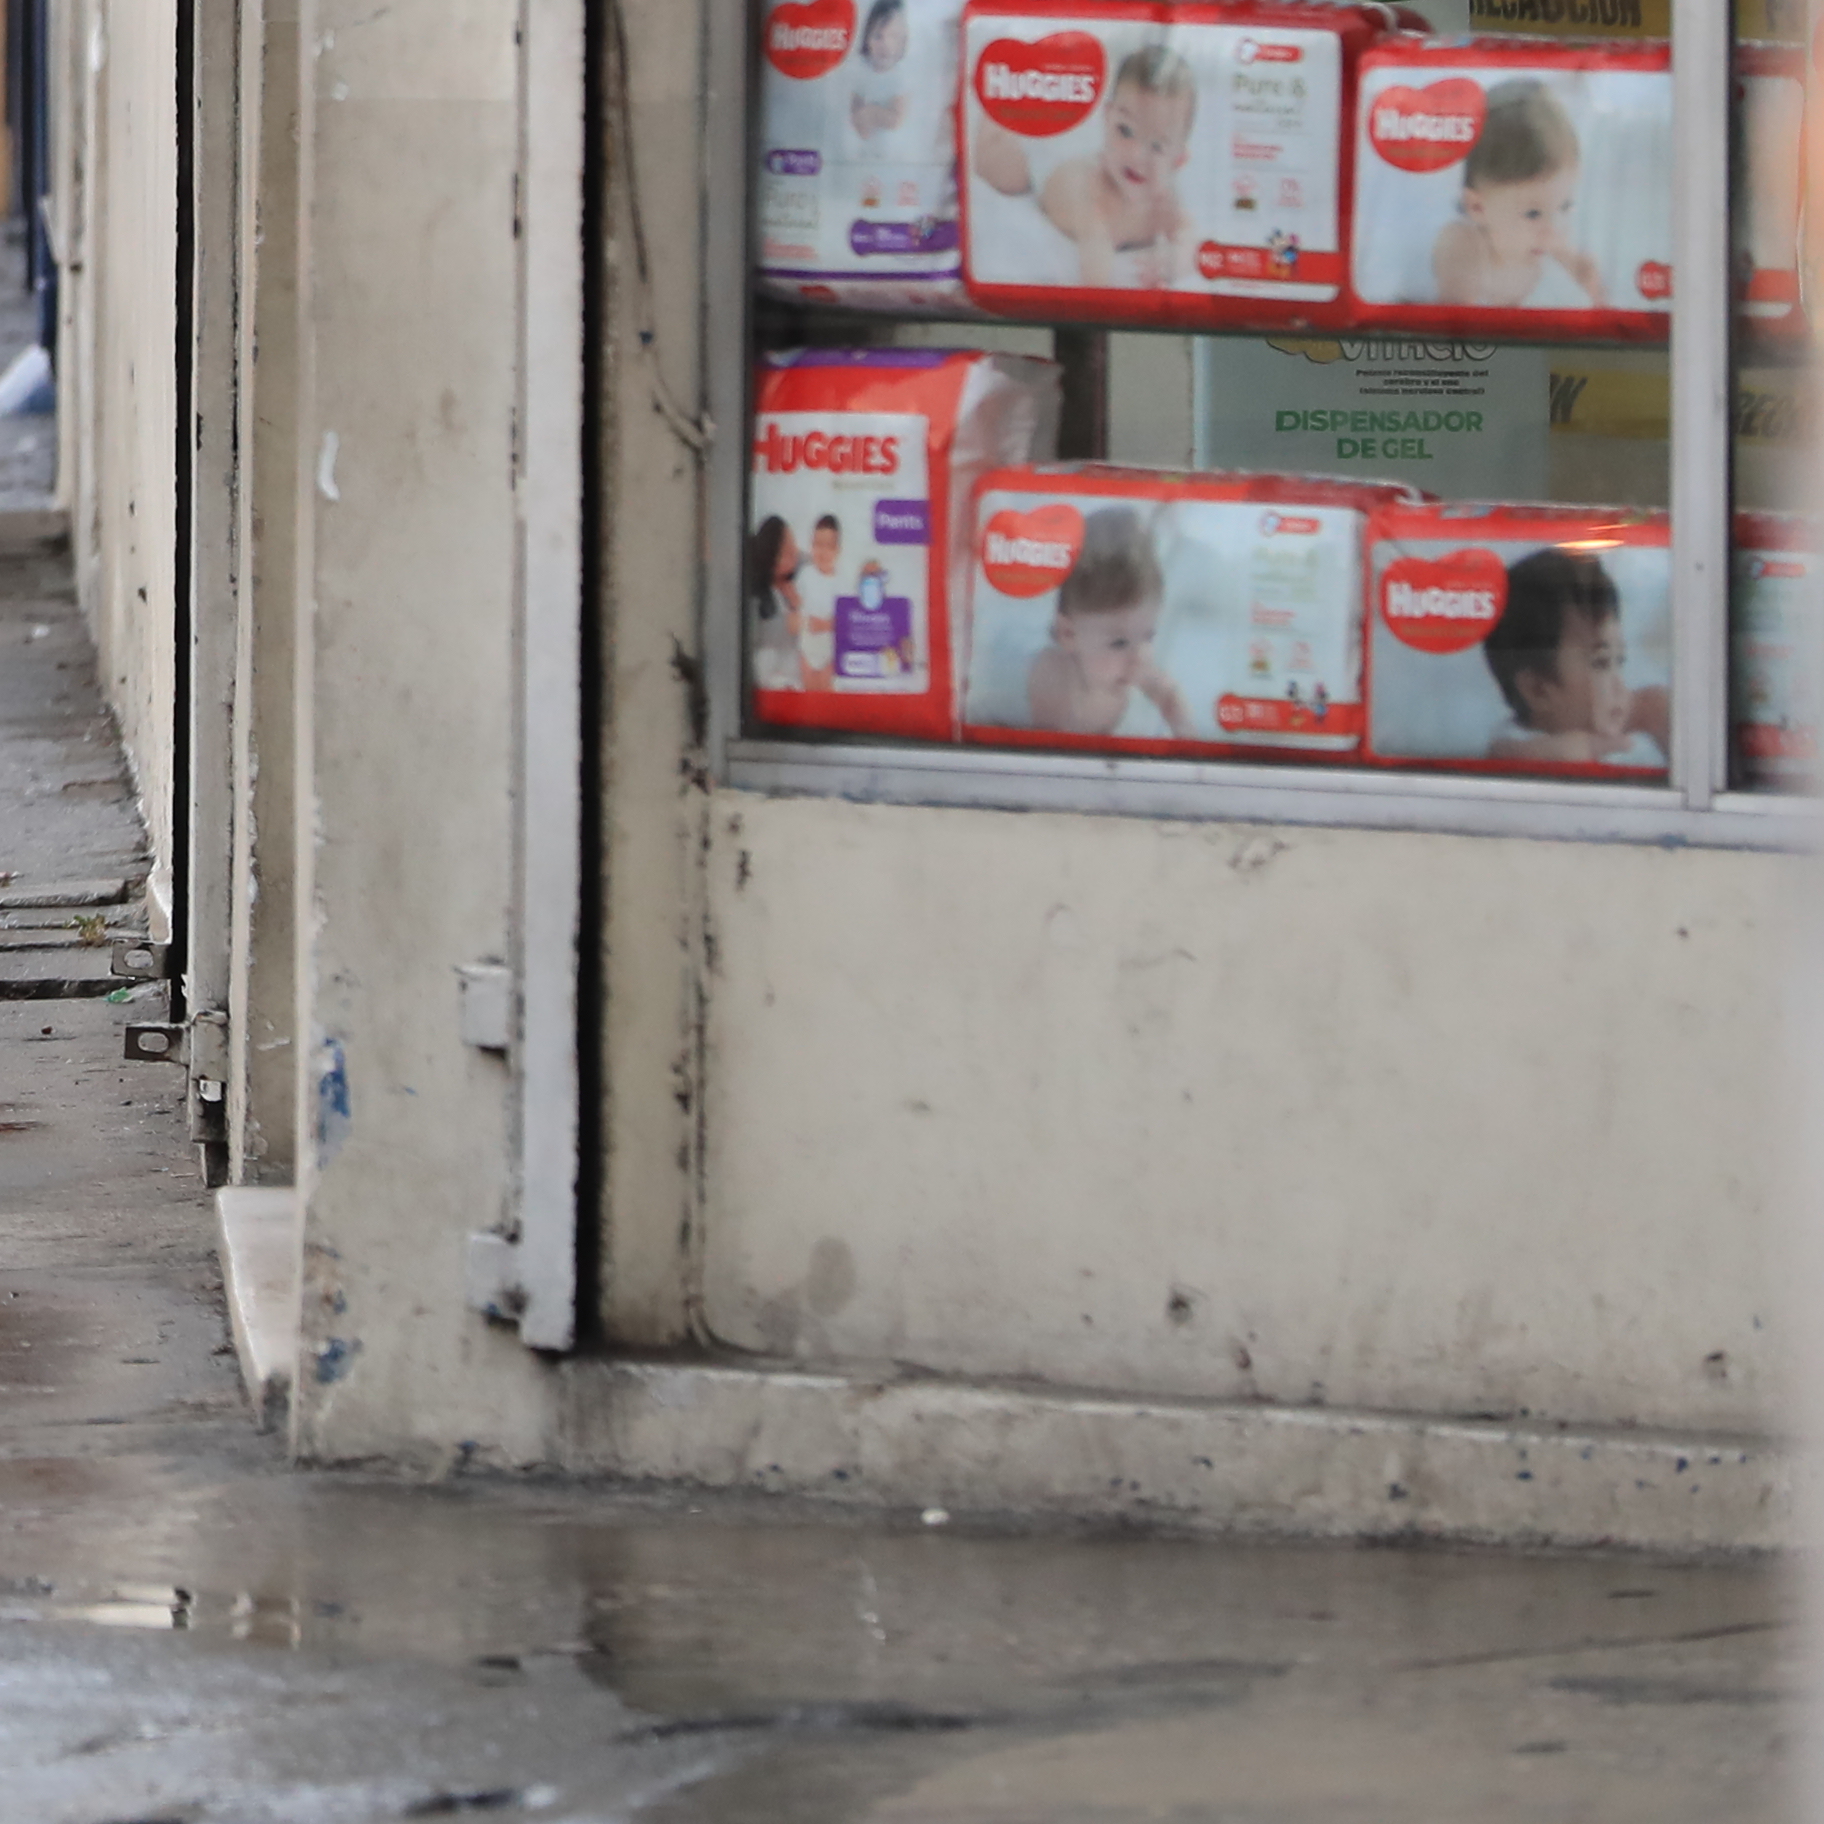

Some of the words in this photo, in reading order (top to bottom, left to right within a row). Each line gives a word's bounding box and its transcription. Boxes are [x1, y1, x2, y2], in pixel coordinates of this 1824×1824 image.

[983, 62, 1096, 105] HUGGIES
[1375, 107, 1475, 143] HUGGIES
[1275, 409, 1484, 433] DISPENSADOR
[753, 423, 899, 475] HUGGIES
[1336, 437, 1377, 460] DE
[1381, 437, 1433, 460] GEL
[986, 531, 1072, 569] HUGGIES
[1388, 581, 1496, 620] HUGGIES
